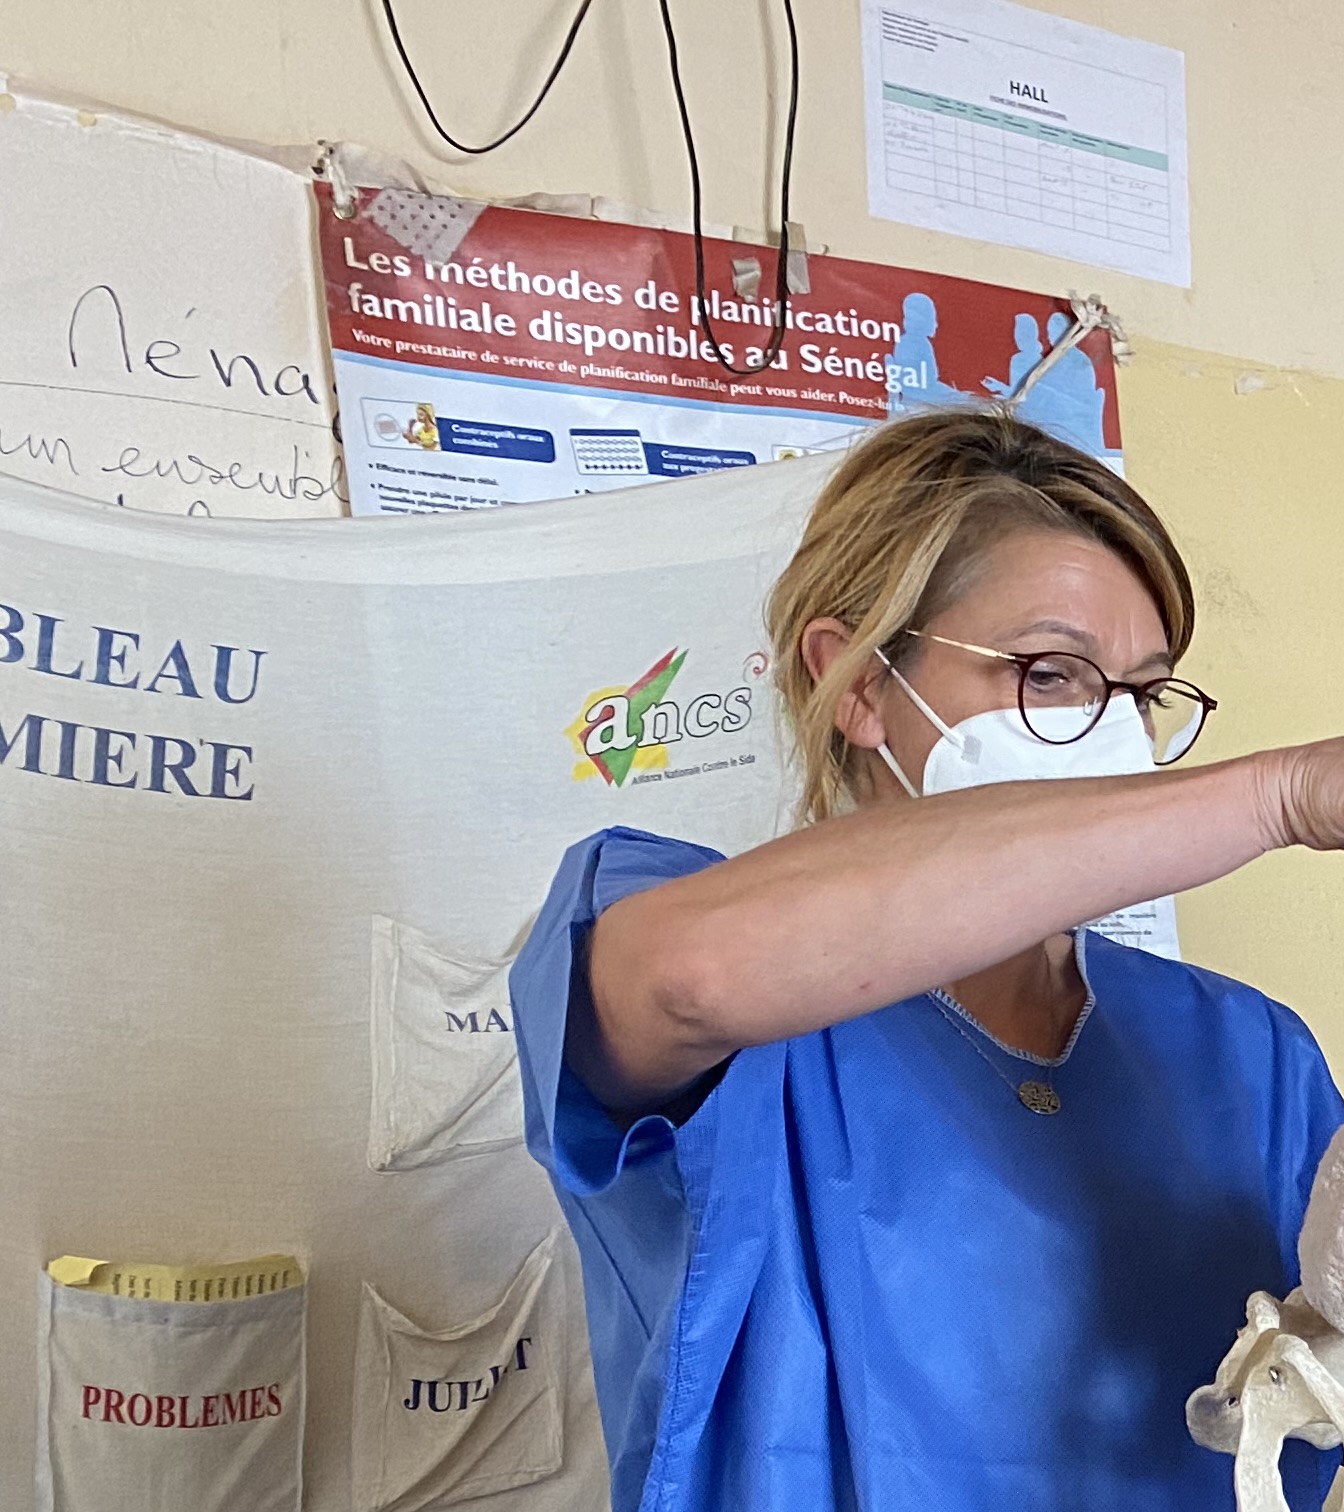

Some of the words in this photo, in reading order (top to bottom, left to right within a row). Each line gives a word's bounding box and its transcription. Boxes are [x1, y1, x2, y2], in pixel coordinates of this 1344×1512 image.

[1009, 80, 1048, 103] HALL
[343, 237, 412, 277] Les
[424, 257, 622, 305] méthodes
[635, 281, 680, 313] de
[348, 282, 517, 337] familiale
[528, 309, 734, 366] disponibles
[745, 345, 788, 371] au
[799, 343, 928, 393] Sénégal
[352, 328, 392, 349] Votre
[395, 338, 477, 362] prestataire
[480, 350, 500, 364] de
[503, 356, 555, 373] service
[558, 360, 577, 374] de
[580, 364, 668, 386] planification
[671, 373, 728, 393] familiale
[730, 384, 762, 399] peut
[765, 387, 798, 400] vous
[800, 389, 837, 404] aider.
[584, 686, 752, 757] ancs
[444, 1007, 514, 1033] MA
[81, 1381, 283, 1429] PROBLEMES
